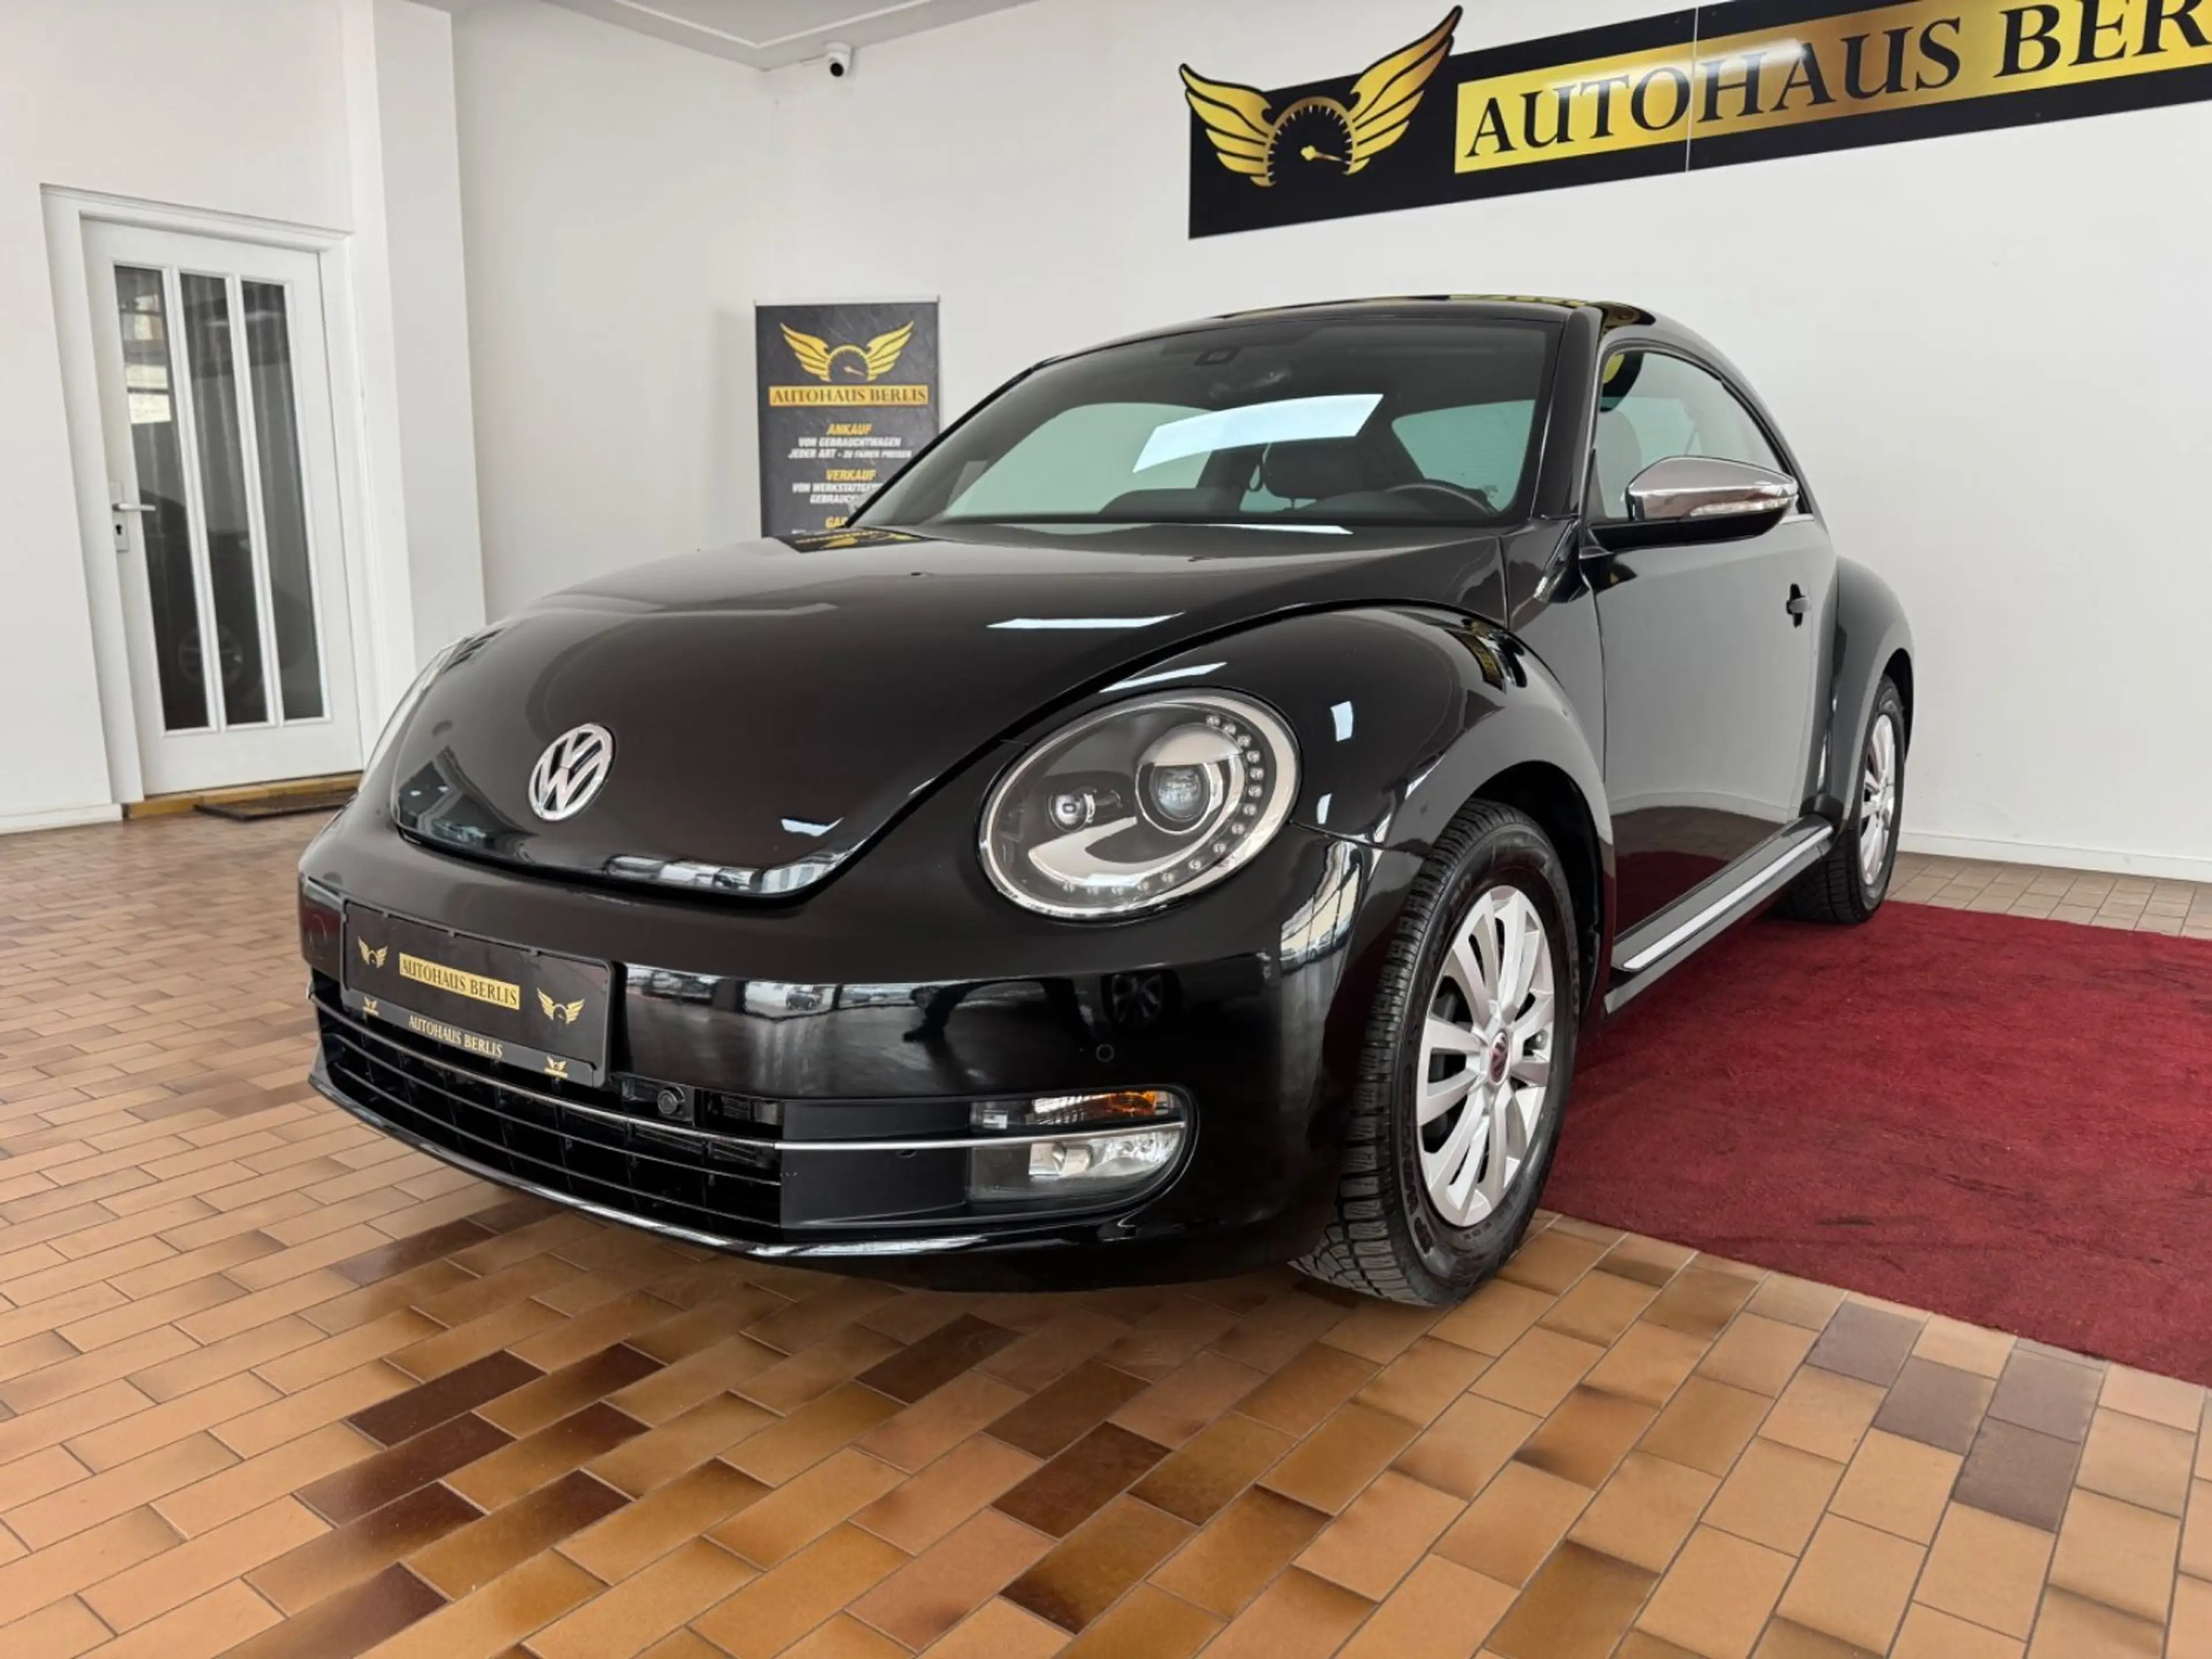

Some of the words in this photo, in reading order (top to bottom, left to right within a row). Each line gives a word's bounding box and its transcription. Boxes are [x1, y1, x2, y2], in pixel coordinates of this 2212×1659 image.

[1464, 17, 1961, 157] AUTOHAUS
[772, 388, 866, 403] AUTOHAUS
[869, 388, 927, 402] BERLIS
[826, 423, 872, 435] ANKAUF
[798, 437, 817, 447] VON
[826, 469, 876, 482] VERKAUF
[792, 482, 811, 493] VON
[403, 958, 466, 992] AUTOHAUS
[469, 978, 517, 1006] BERLIS
[408, 1014, 461, 1049] AUTOHAUS
[464, 1034, 503, 1059] BERLIS
